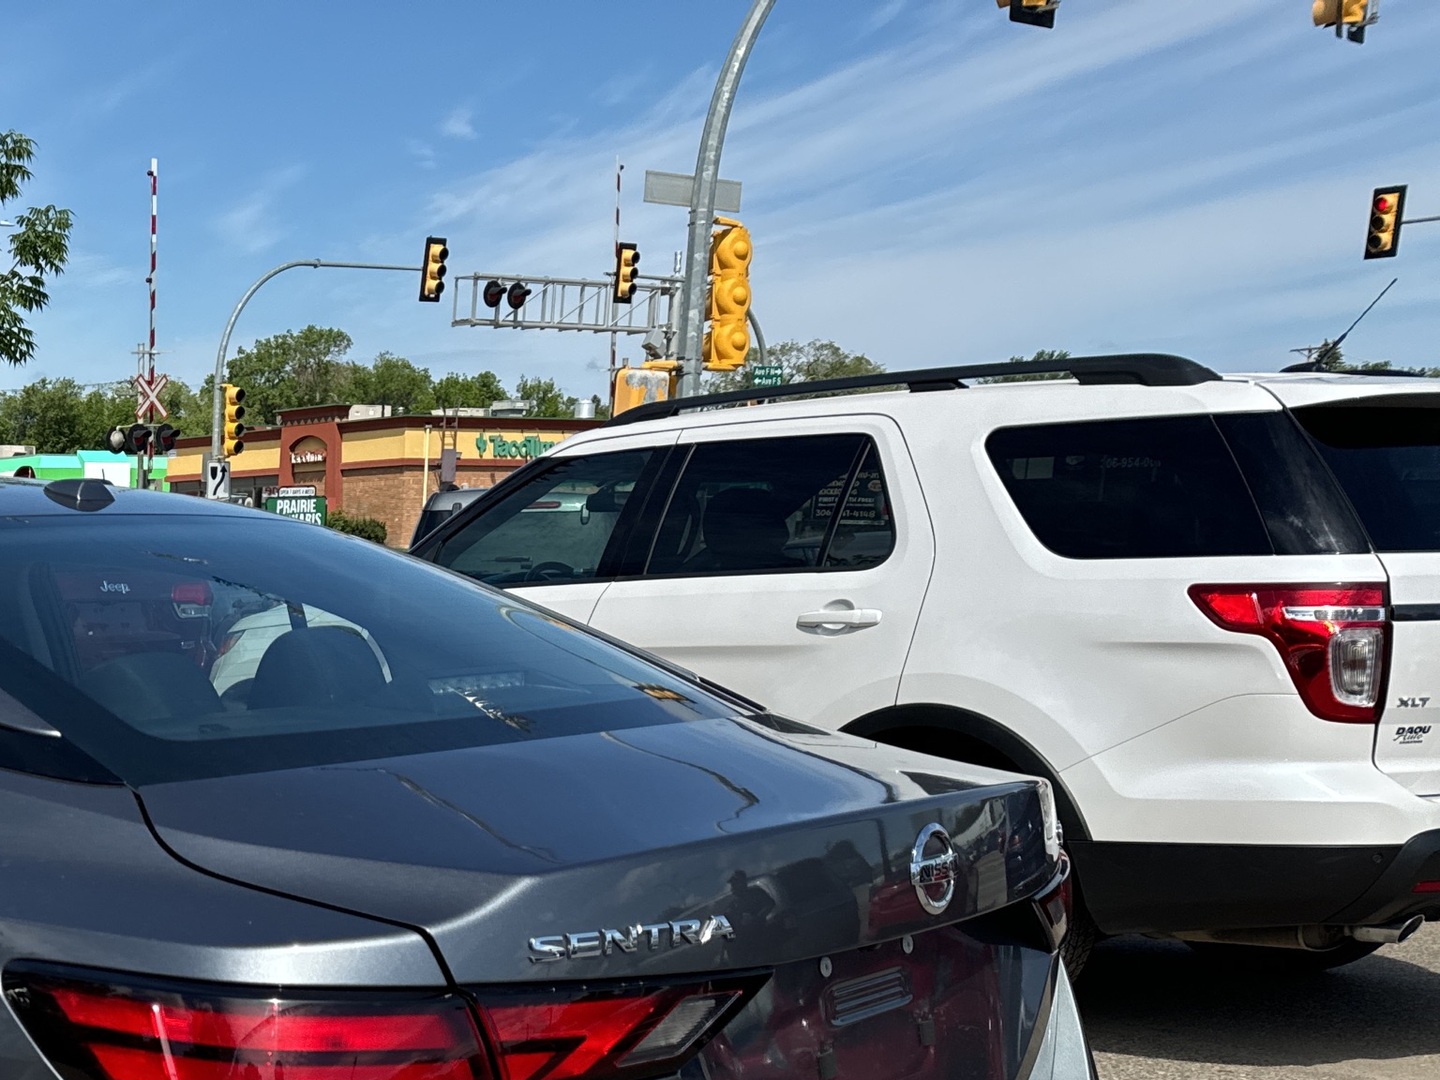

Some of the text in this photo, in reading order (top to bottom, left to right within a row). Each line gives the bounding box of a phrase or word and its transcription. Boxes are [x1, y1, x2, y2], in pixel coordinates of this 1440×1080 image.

[489, 435, 557, 459] TacoTim
[276, 499, 317, 515] PRAIRIE
[100, 580, 131, 594] Jeep
[1396, 697, 1431, 708] XLT
[1395, 725, 1432, 735] DAOU
[920, 853, 959, 882] NISS
[528, 914, 736, 962] SENTRA
